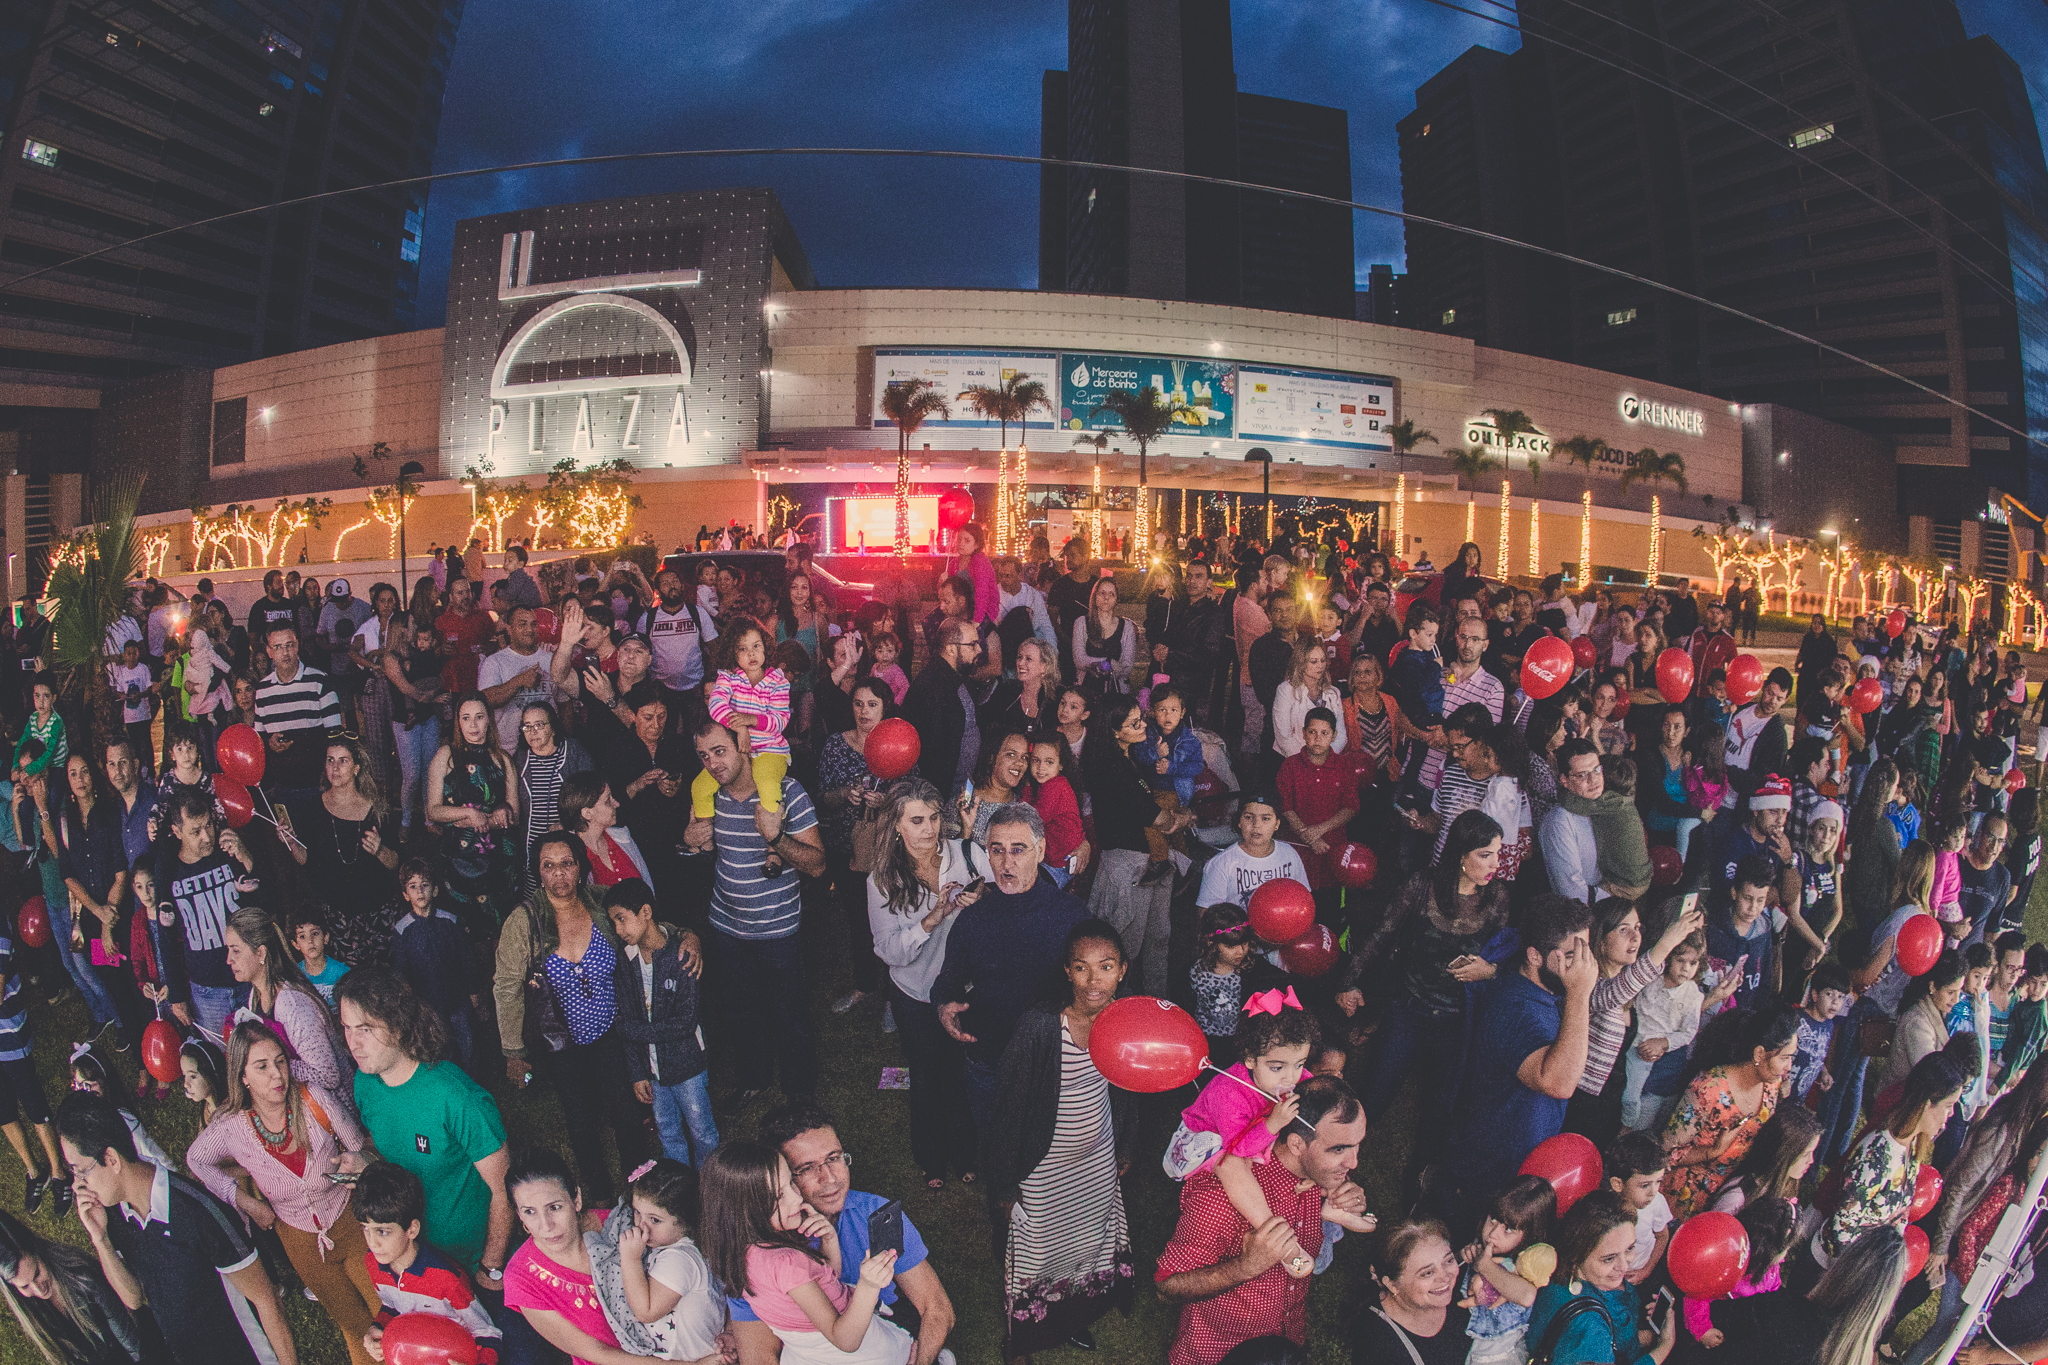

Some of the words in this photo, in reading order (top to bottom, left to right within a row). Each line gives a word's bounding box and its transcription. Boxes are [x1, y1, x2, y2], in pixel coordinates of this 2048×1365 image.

[1092, 366, 1138, 379] Mercearia
[1108, 378, 1138, 390] Banho
[488, 392, 690, 458] PLAZA
[1641, 400, 1704, 437] RENNER
[171, 863, 235, 898] BETTER
[1236, 866, 1264, 895] ROCK
[175, 881, 241, 951] DAYS
